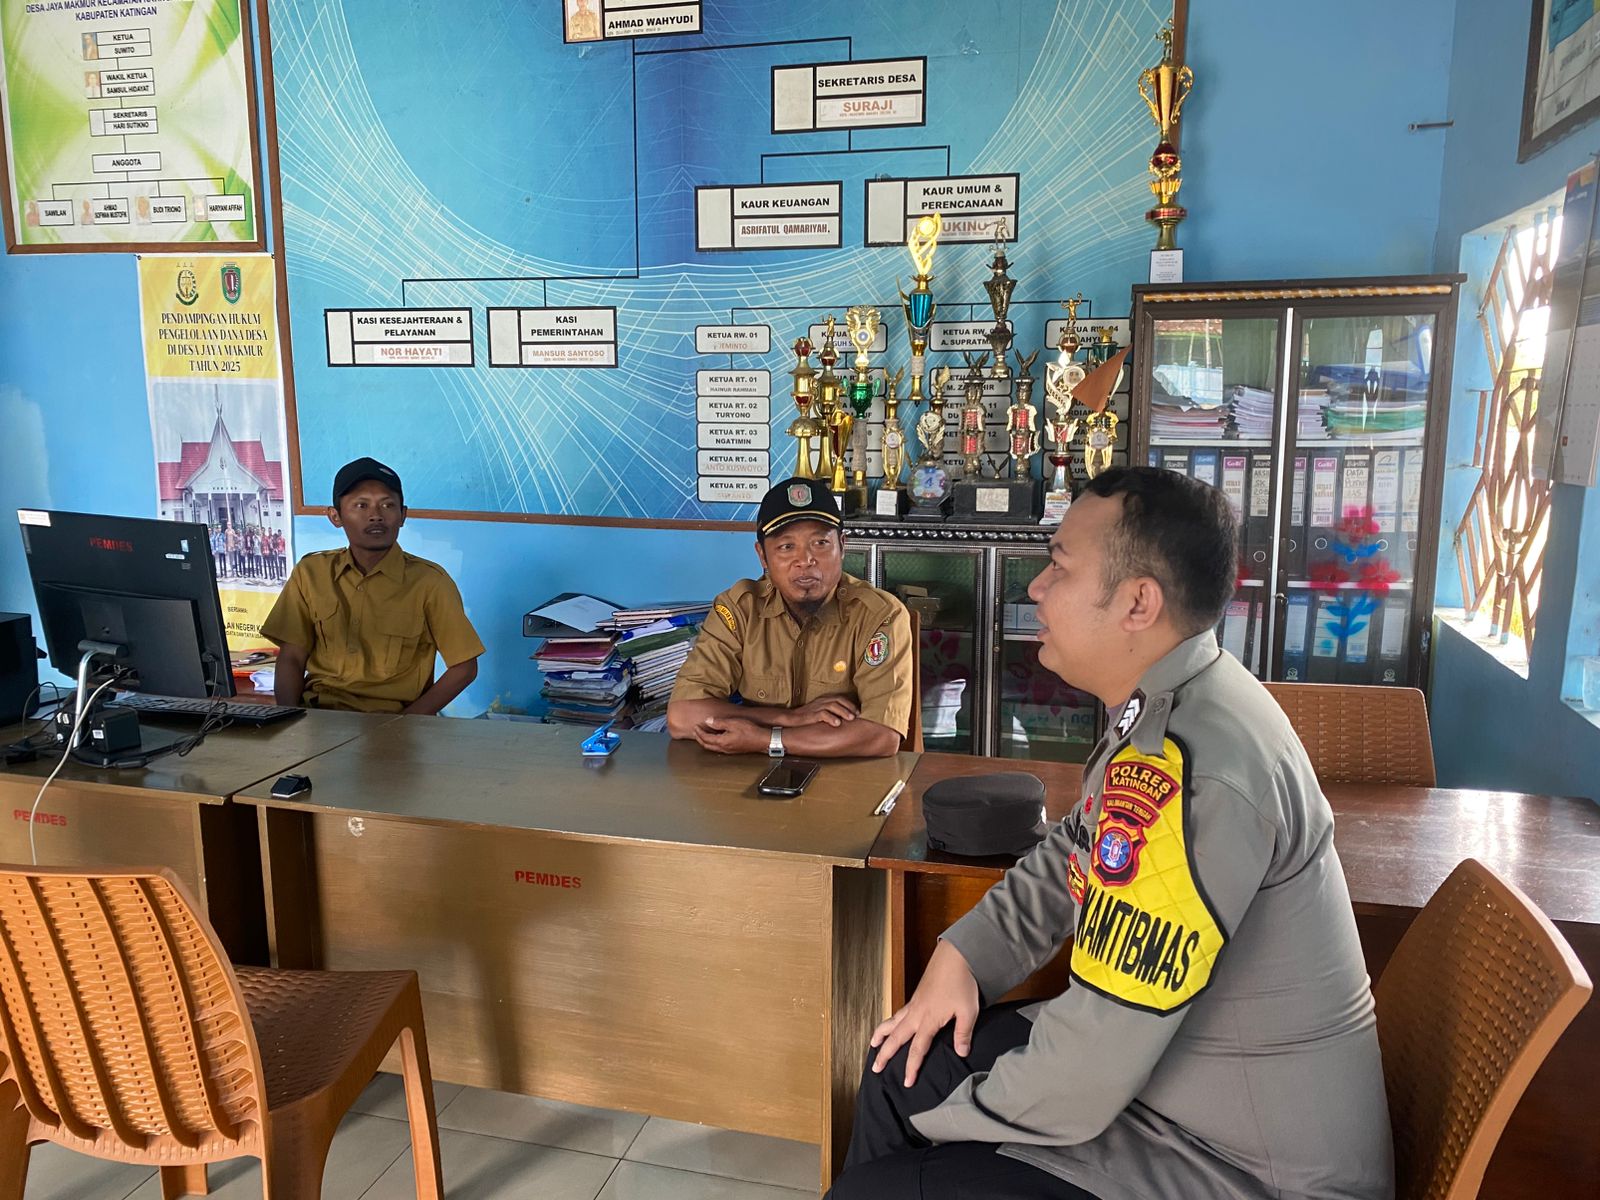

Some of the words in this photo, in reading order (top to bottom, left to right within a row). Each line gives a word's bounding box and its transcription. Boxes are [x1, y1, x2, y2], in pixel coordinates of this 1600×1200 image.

[26, 4, 45, 13] DESA
[46, 2, 63, 11] JAYA
[64, 0, 96, 10] MAKMUR
[76, 10, 118, 21] KABUPATEN
[120, 6, 157, 18] KATINGAN
[608, 19, 643, 29] AHMAD
[646, 15, 693, 26] WAHYUDI
[126, 72, 148, 80] KETUA
[818, 76, 884, 88] SEKRETARIS
[888, 74, 916, 84] DESA
[843, 100, 893, 112] SURAJI
[923, 187, 953, 196] KAUR
[956, 185, 991, 194] UMUM
[994, 184, 1002, 192] &
[741, 200, 769, 208] KAUR
[772, 198, 830, 207] KEUANGAN
[922, 198, 1003, 210] PERENCANAAN
[741, 225, 780, 235] ASRIFATUL
[784, 224, 830, 234] QAMARIYAH.
[161, 313, 229, 324] PENDAMPINGAN
[229, 313, 260, 324] HUKUM
[159, 329, 219, 340] PENGELOLAAN
[220, 330, 244, 340] DANA
[246, 330, 267, 340] DESA
[167, 344, 176, 355] DI
[178, 344, 199, 356] DESA
[200, 345, 222, 356] JAYA
[224, 345, 263, 356] MAKMUR
[381, 348, 400, 356] NOR
[189, 360, 219, 371] TAHUN
[221, 361, 240, 372] 2025
[236, 623, 255, 632] NEGERI
[1111, 766, 1171, 794] POLRES
[1112, 776, 1162, 800] KATINGAN
[14, 809, 67, 826] PEMDES
[514, 870, 582, 888] PEMDES
[1076, 884, 1200, 992] KAMTIBMAS
